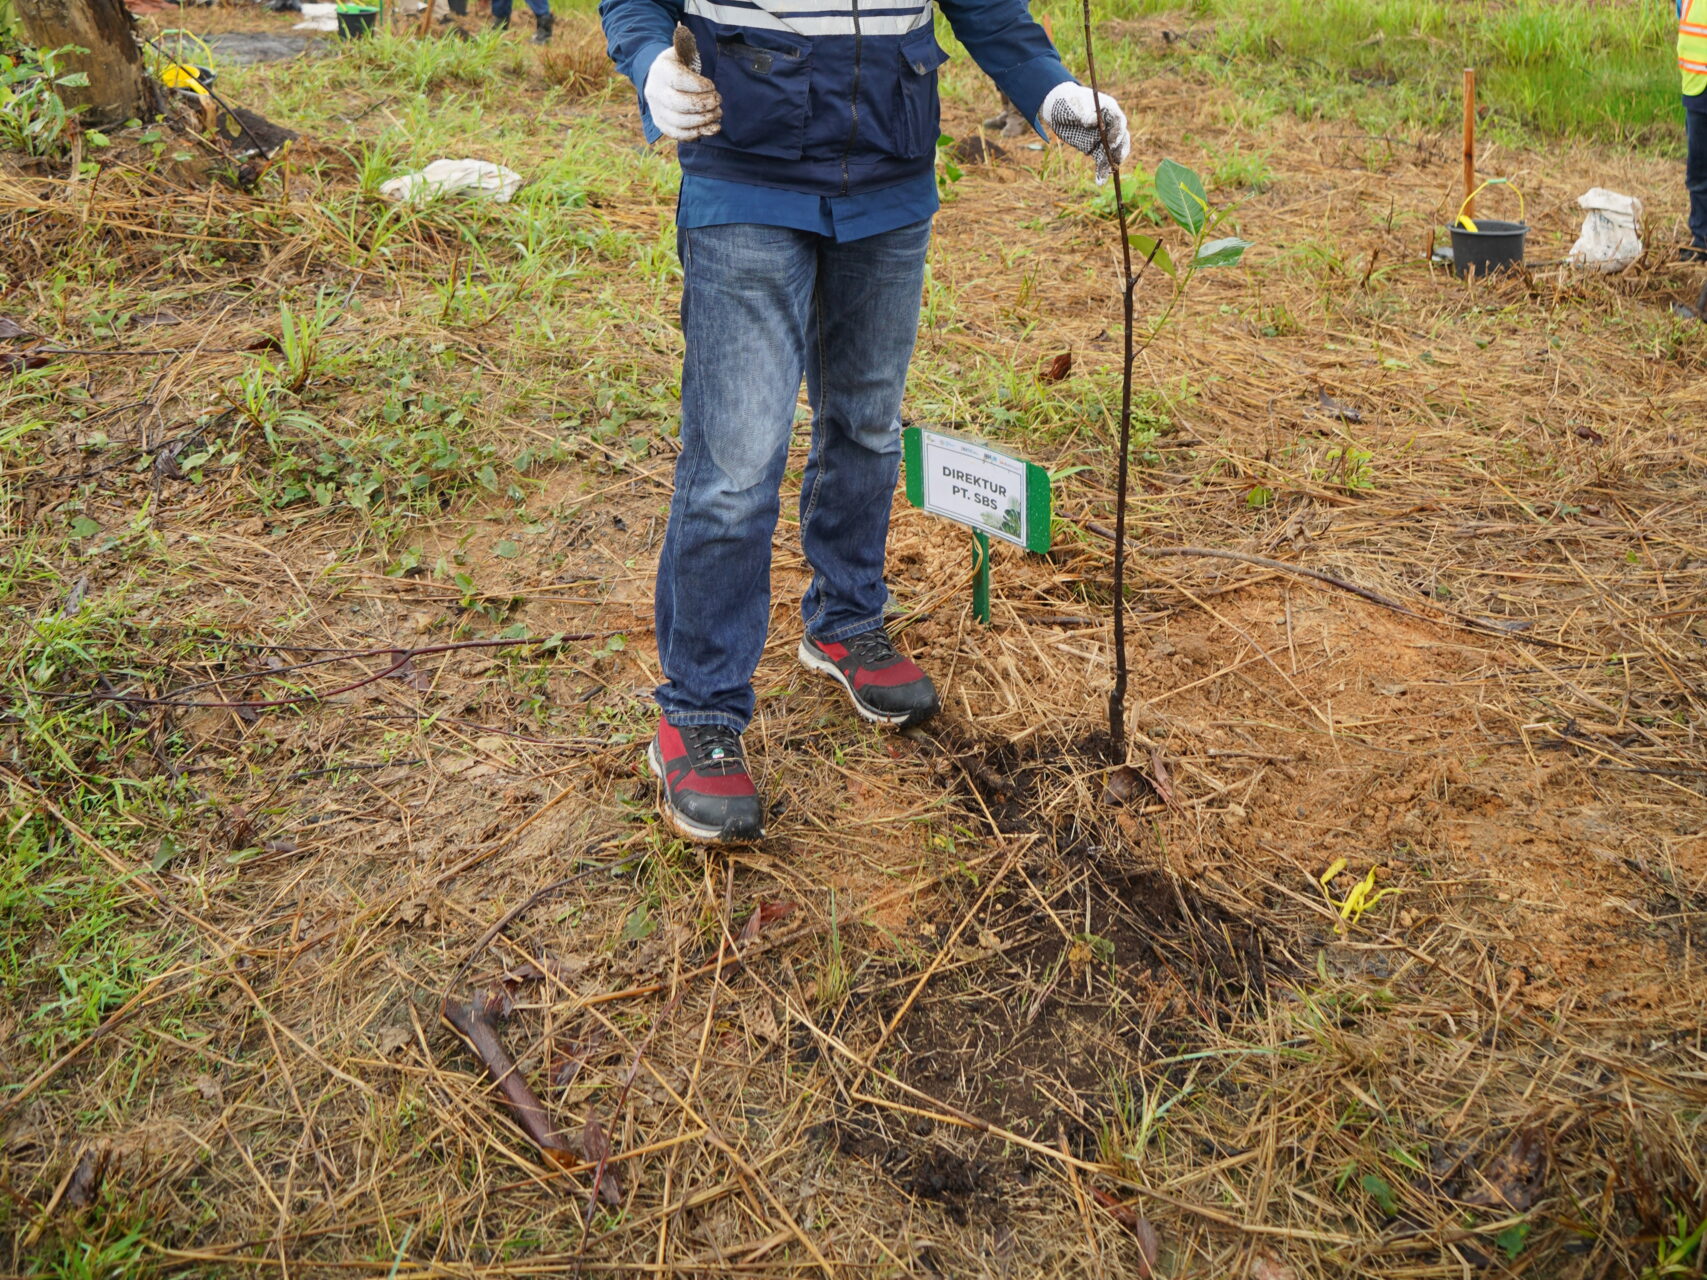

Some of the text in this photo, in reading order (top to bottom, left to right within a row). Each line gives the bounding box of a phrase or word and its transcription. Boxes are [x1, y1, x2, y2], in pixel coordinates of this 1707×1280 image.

[942, 465, 1007, 497] DIREKTUR
[952, 484, 998, 511] PT. SBS
